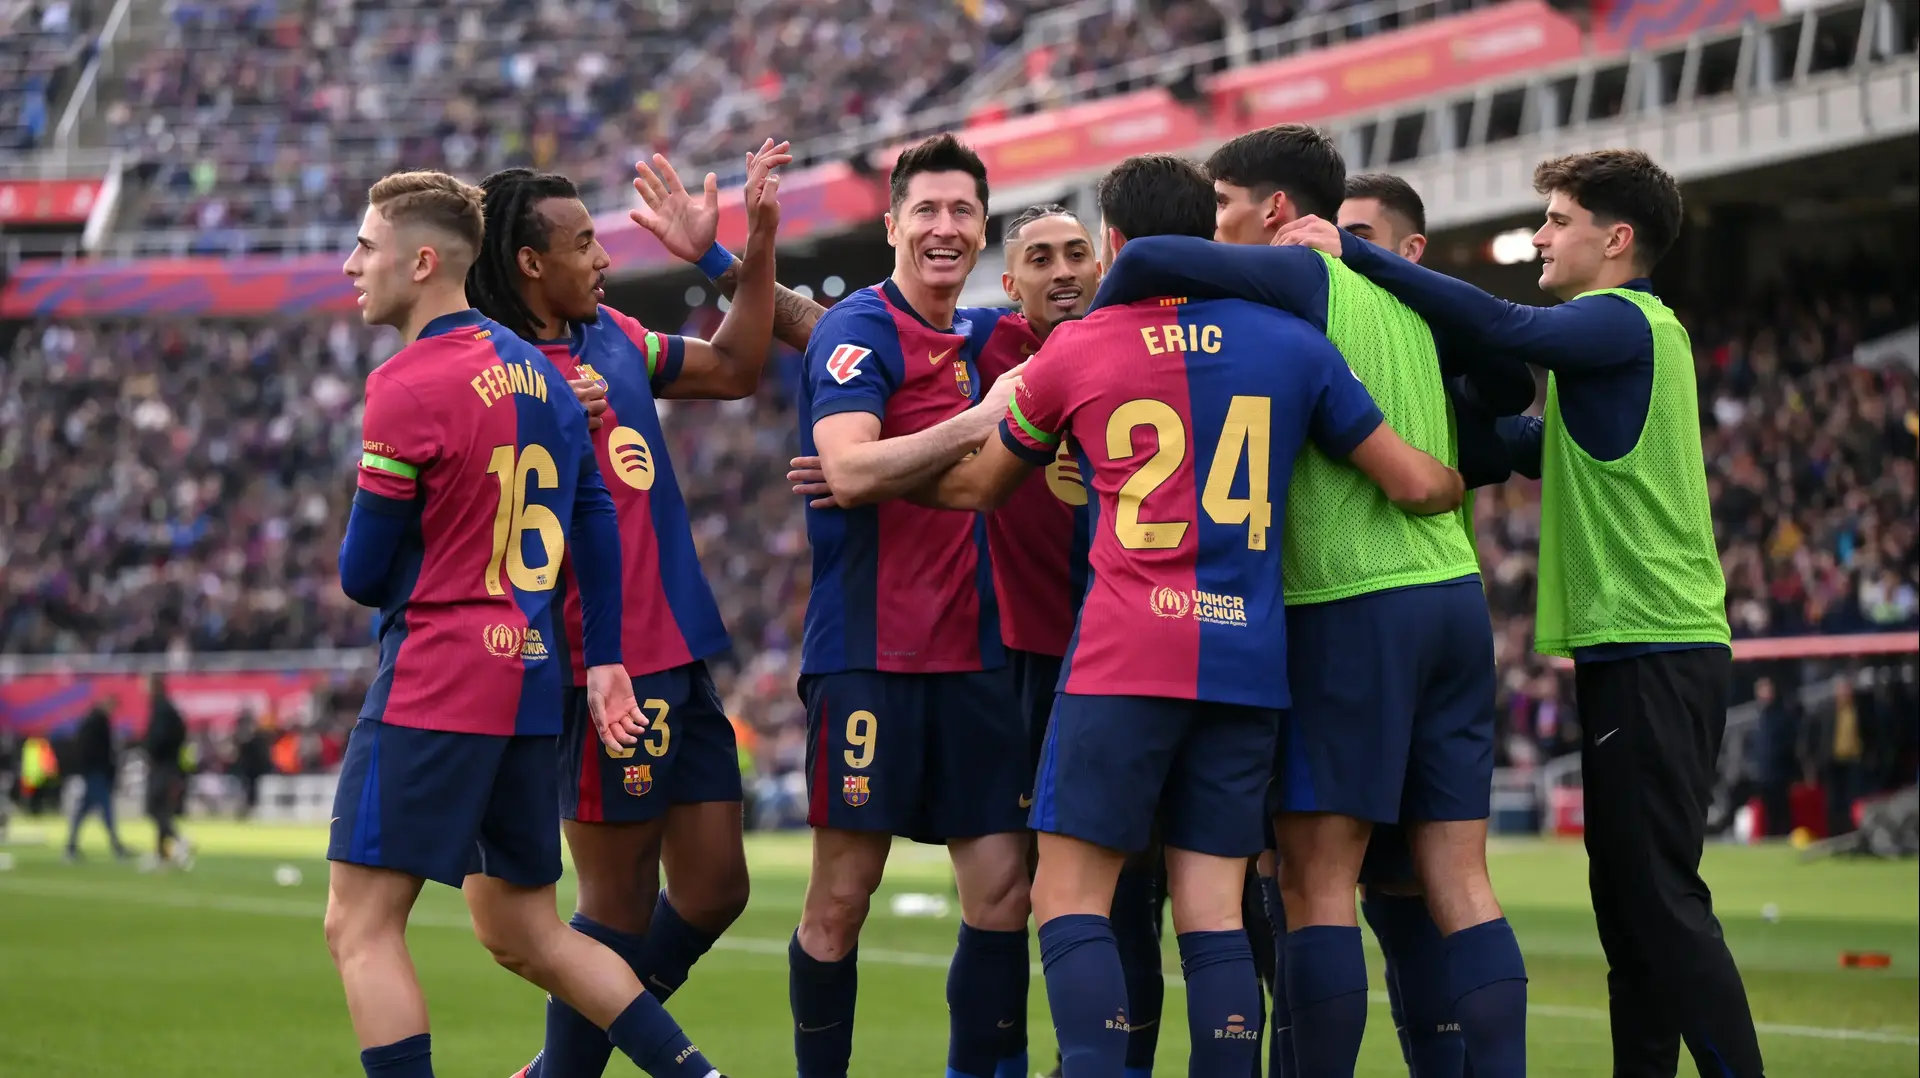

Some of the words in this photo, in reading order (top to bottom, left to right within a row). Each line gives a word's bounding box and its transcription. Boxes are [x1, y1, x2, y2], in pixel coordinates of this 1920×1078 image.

[1140, 324, 1223, 355] ERIC
[1105, 395, 1271, 551] 24
[485, 443, 564, 596] 16
[1191, 589, 1245, 610] UNHCR
[1192, 602, 1247, 621] ACNUR
[1230, 620, 1248, 628] Agency
[605, 698, 671, 759] 3
[843, 709, 878, 769] 9
[1437, 1022, 1461, 1033] BAR
